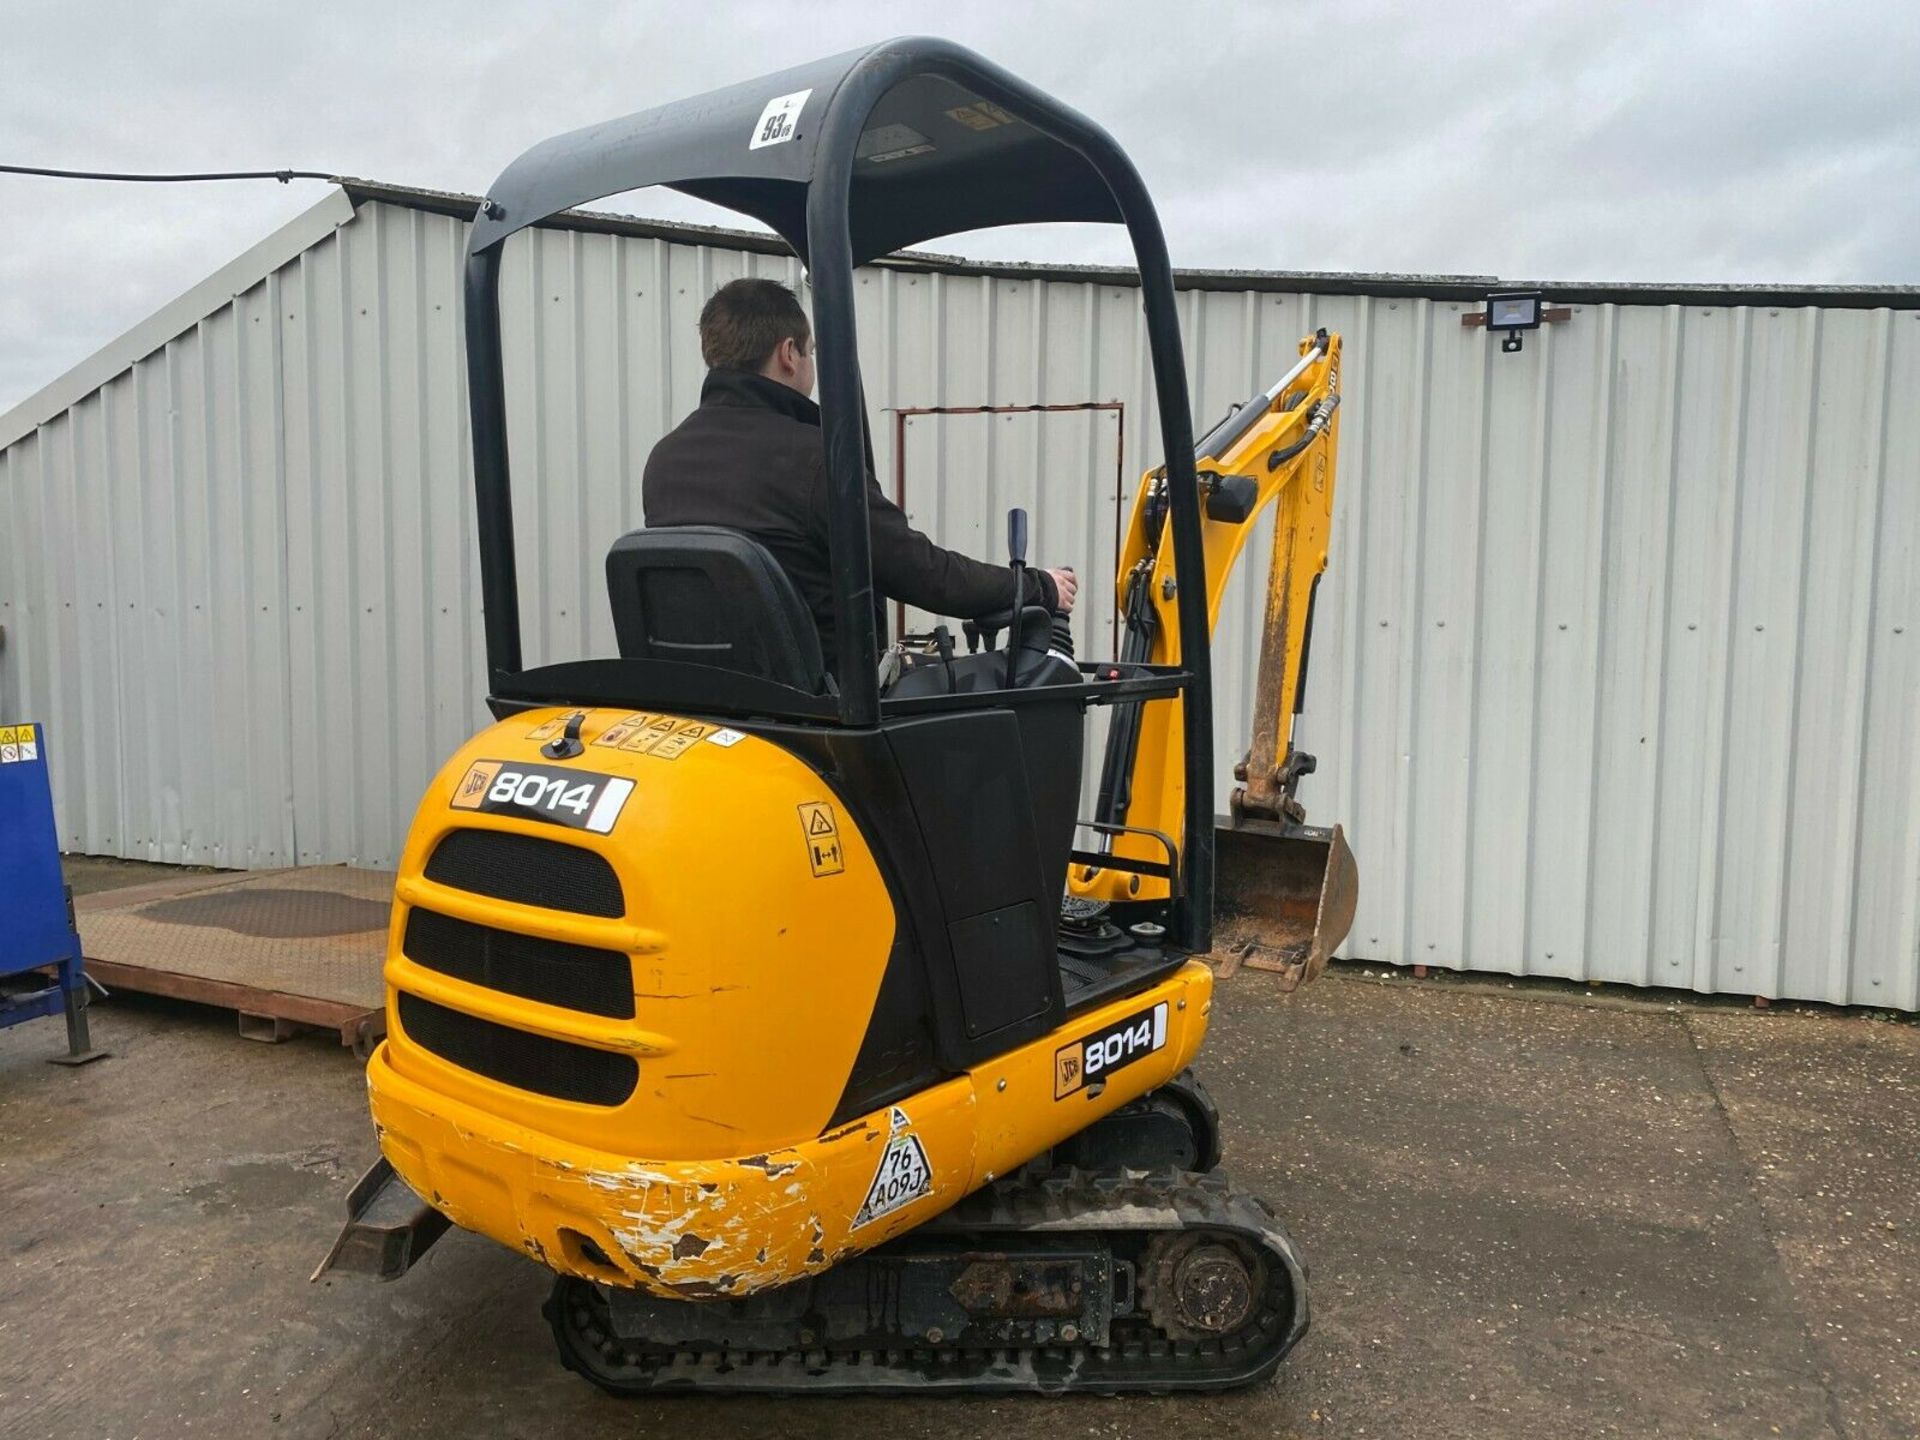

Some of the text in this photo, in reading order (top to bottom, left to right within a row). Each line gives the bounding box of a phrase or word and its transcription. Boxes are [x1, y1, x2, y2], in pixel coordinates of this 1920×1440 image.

[466, 772, 595, 815] JCB 8014
[1085, 1019, 1151, 1074] 8014
[890, 1145, 912, 1177] 76
